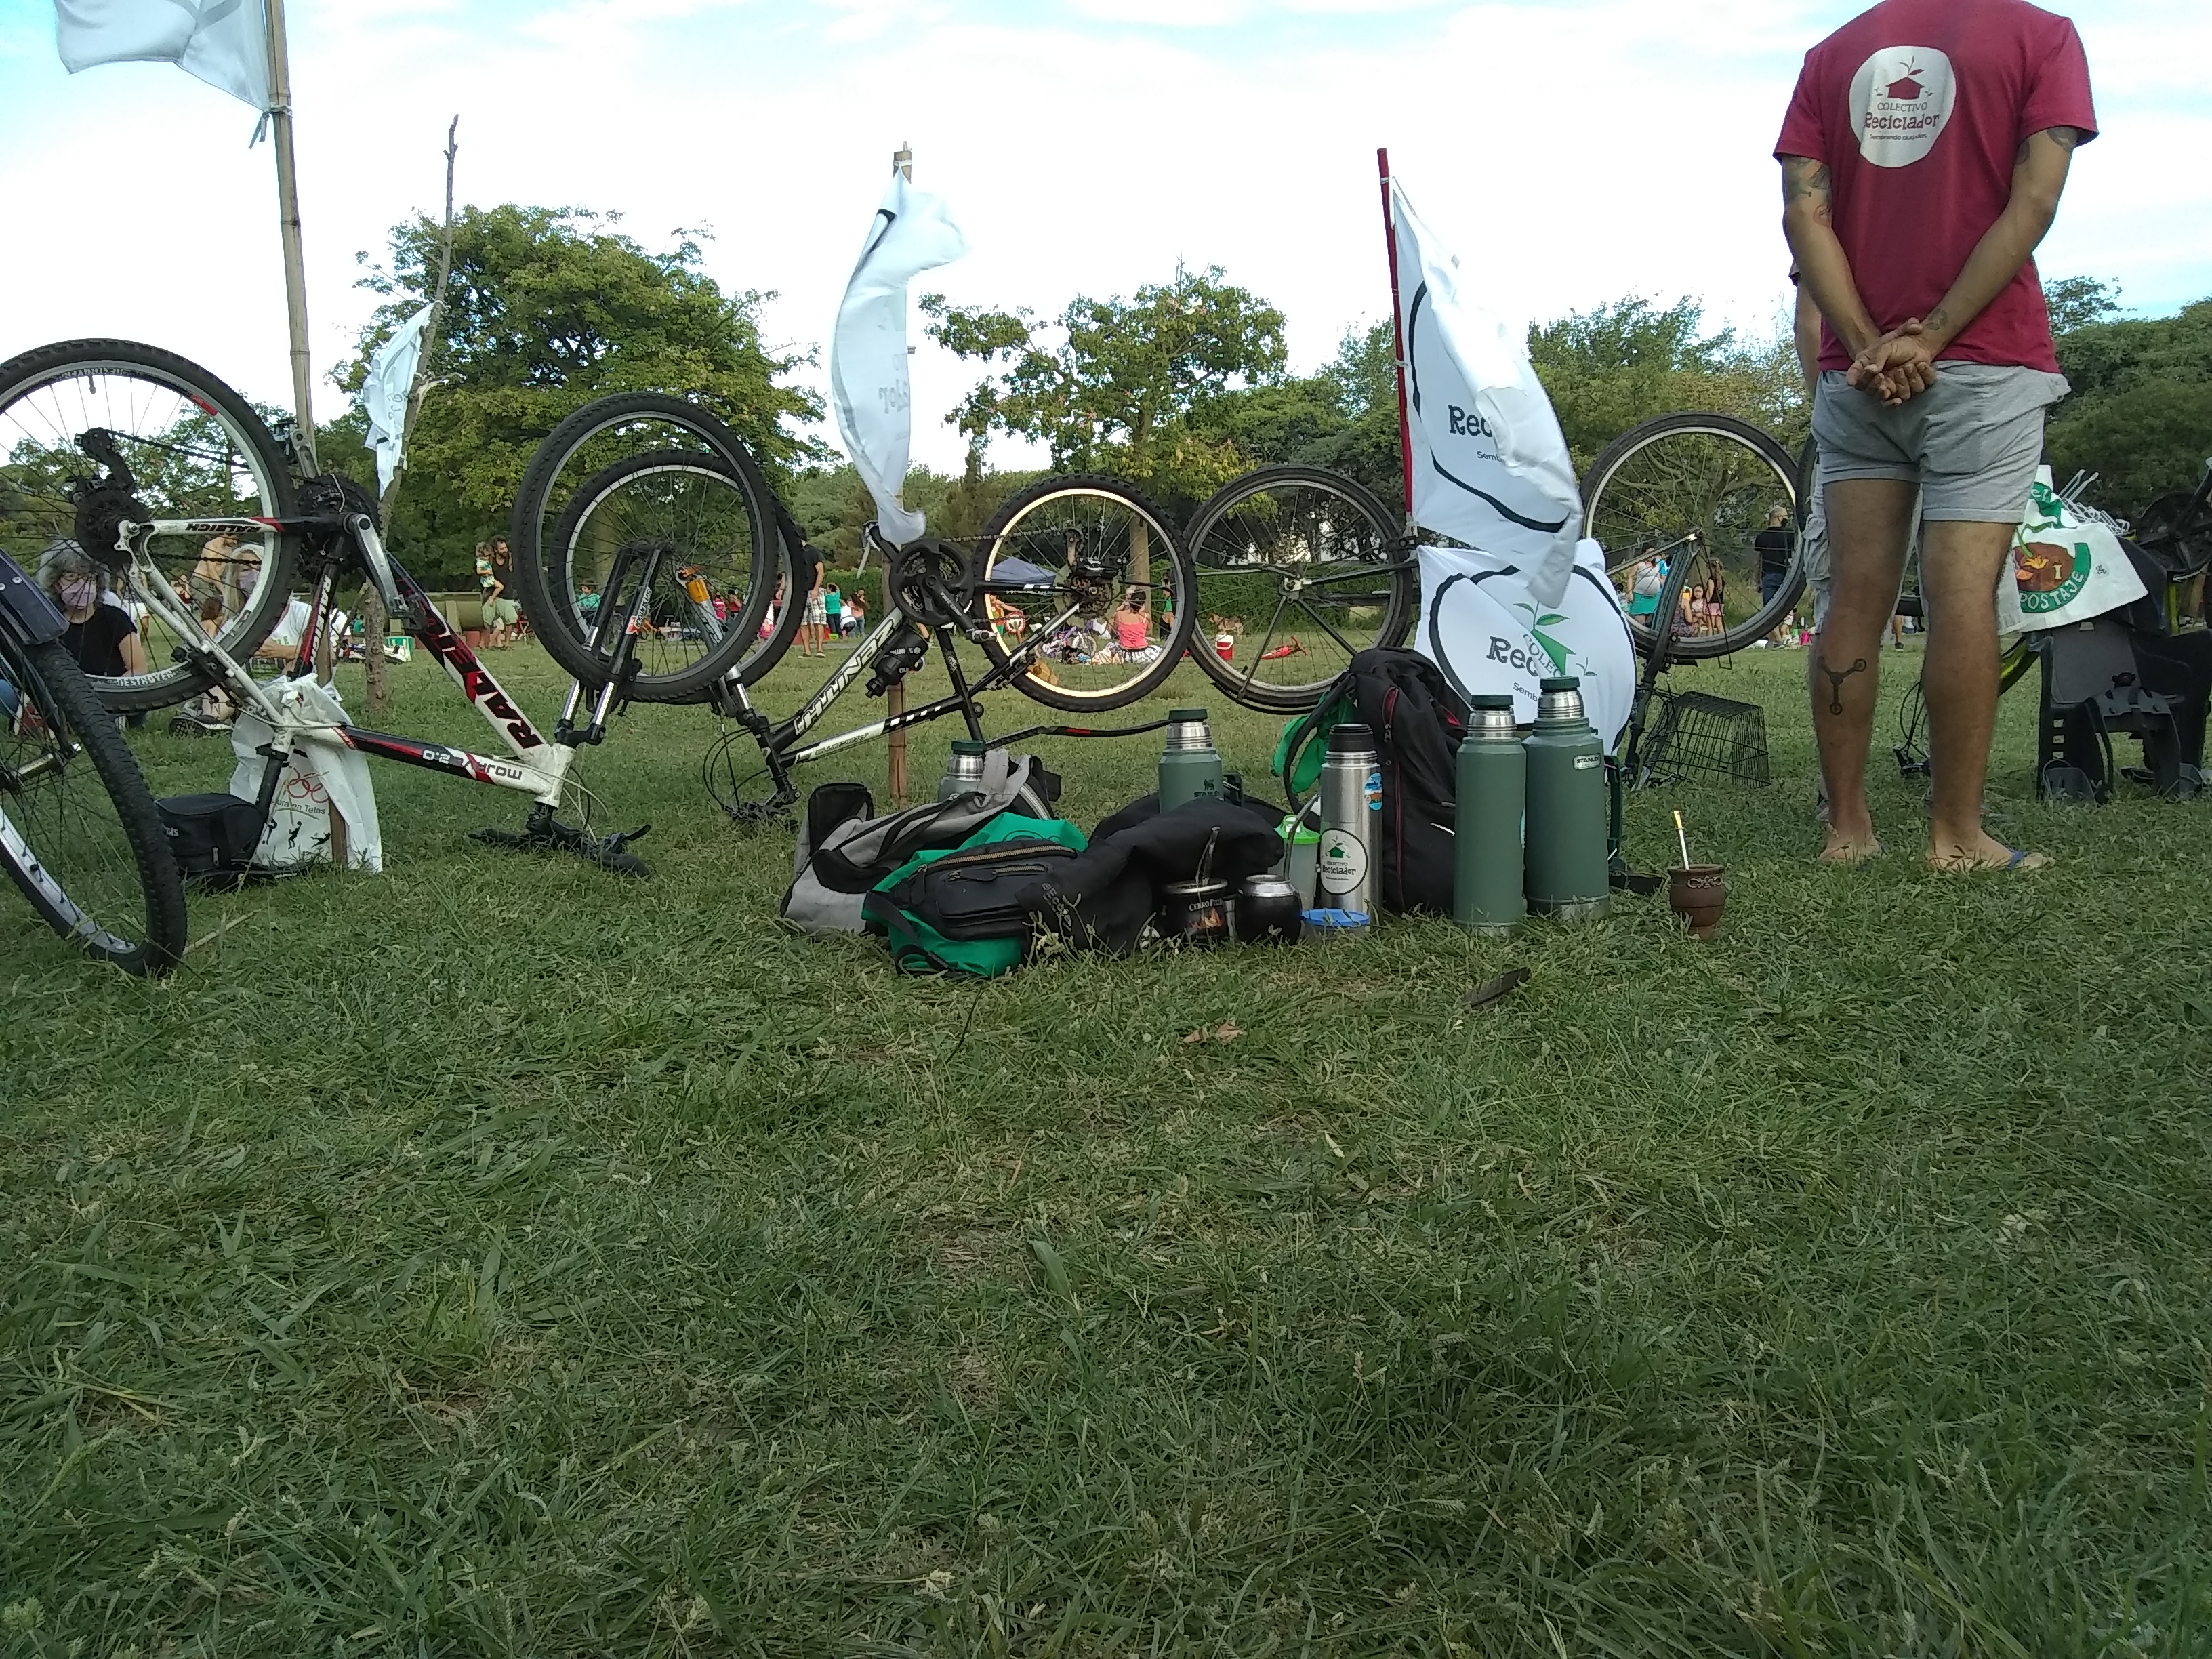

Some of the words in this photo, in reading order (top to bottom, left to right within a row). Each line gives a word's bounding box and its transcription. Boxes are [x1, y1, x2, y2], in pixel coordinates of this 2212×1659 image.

[1877, 102, 1927, 112] COLECTIVO
[1865, 112, 1940, 131] Reciclador
[184, 523, 262, 533] RALEIGH
[422, 749, 451, 765] 2.0
[304, 804, 326, 815] Telas
